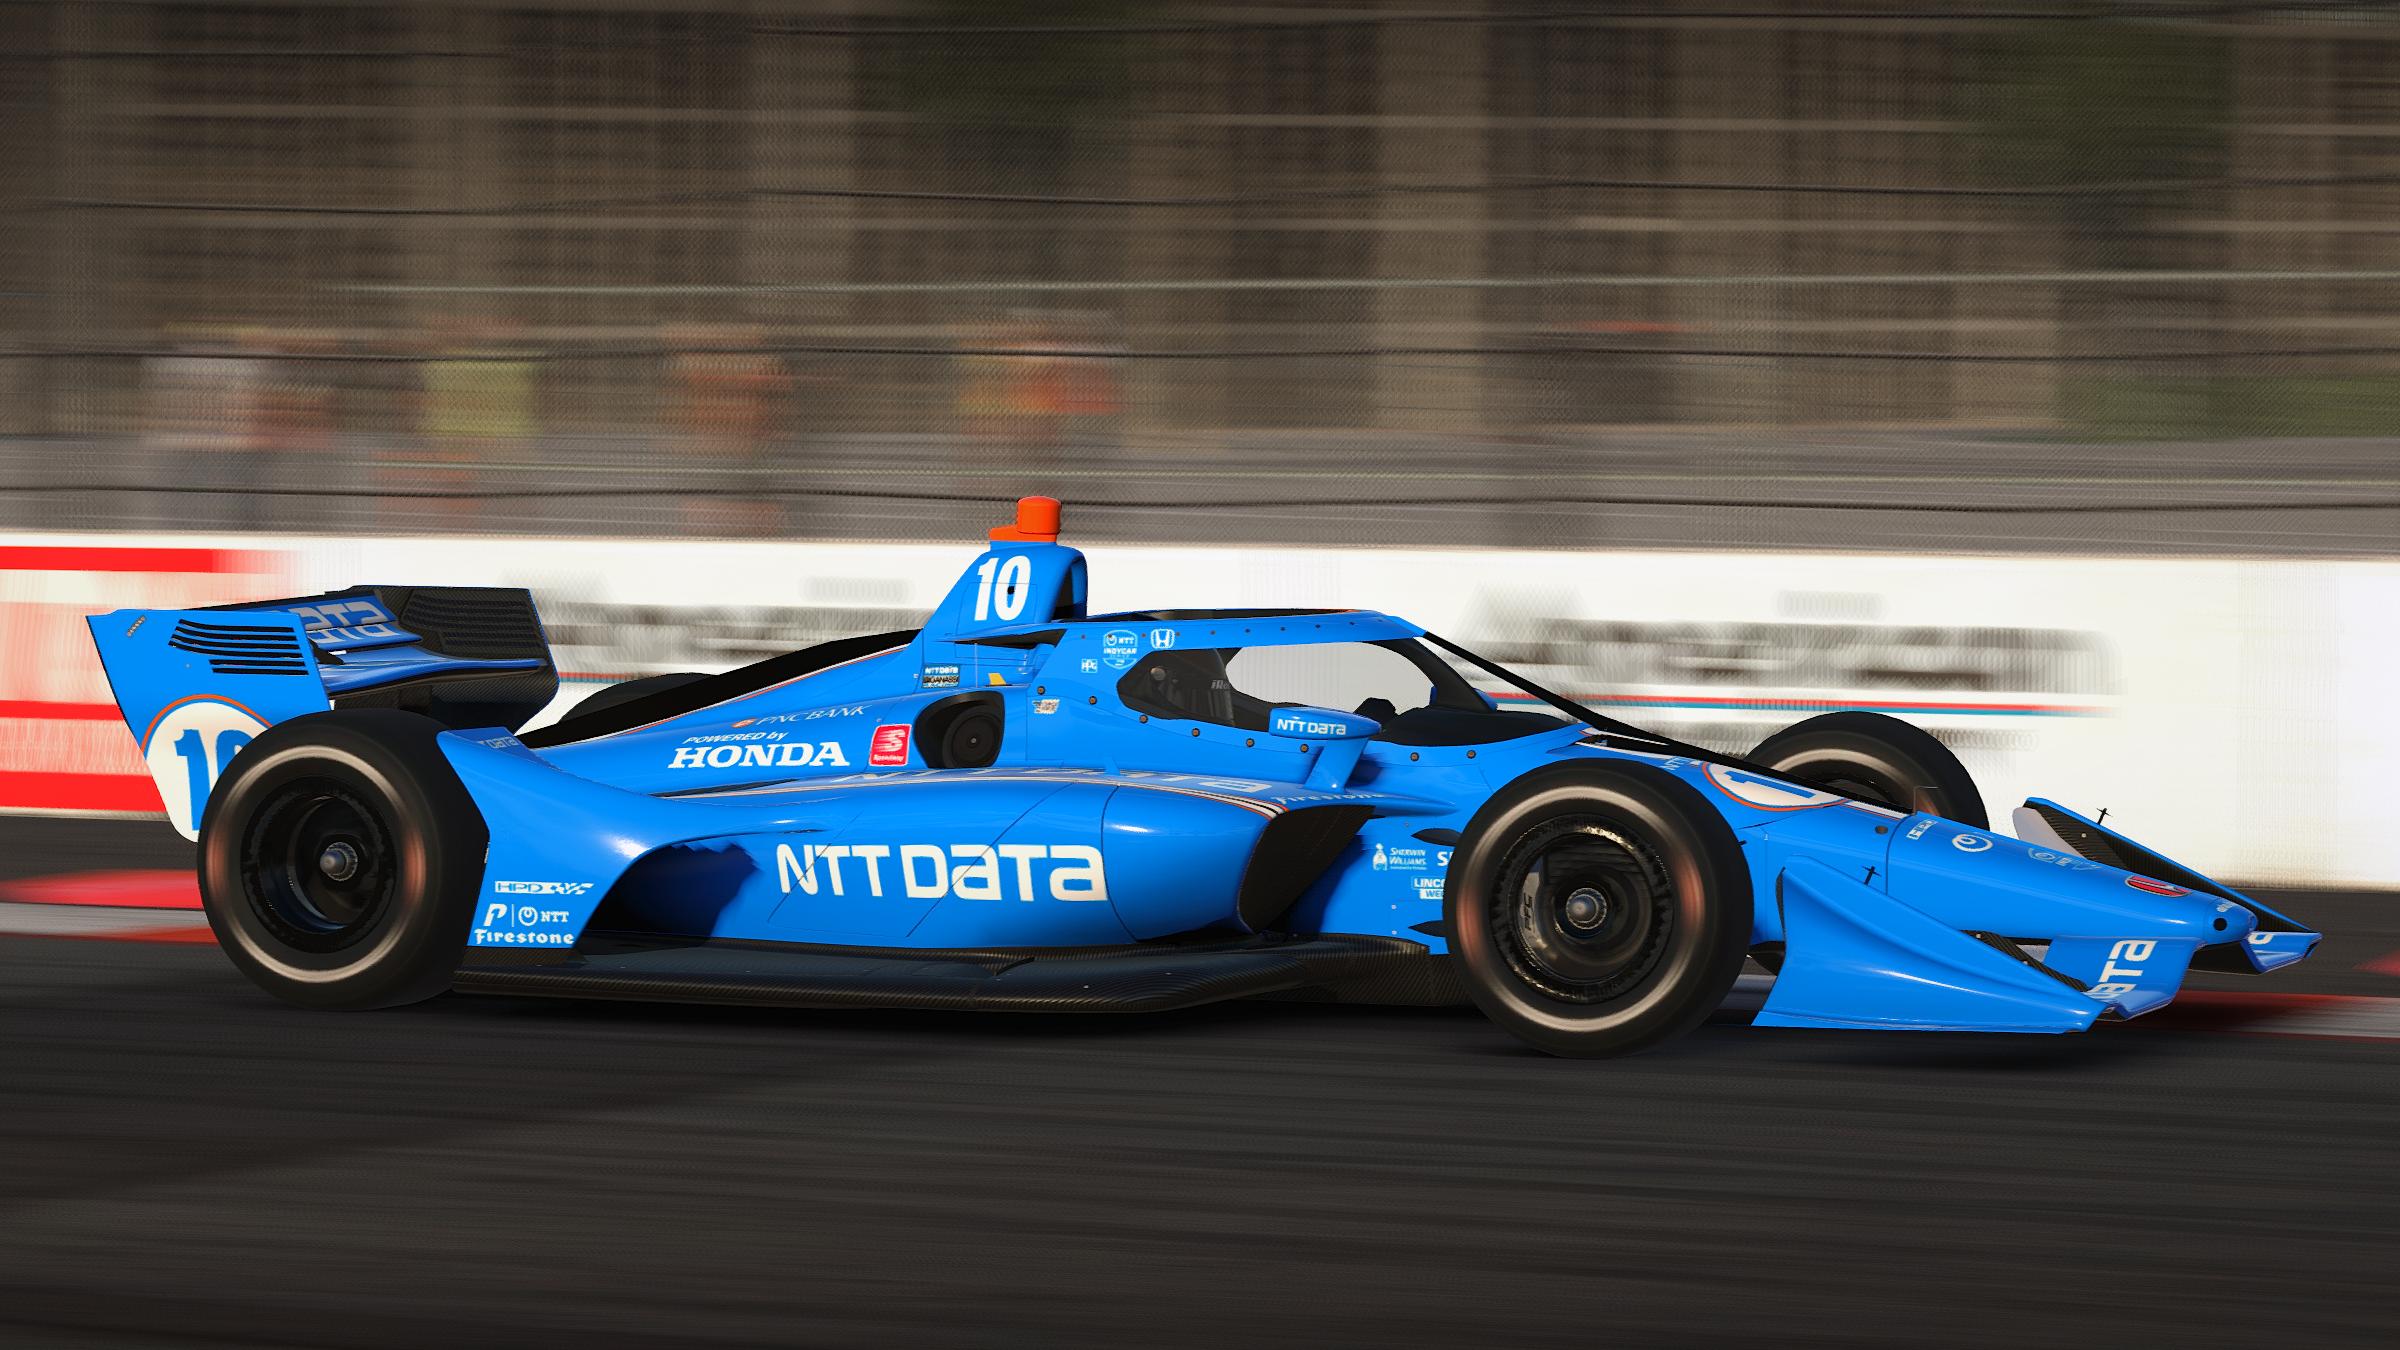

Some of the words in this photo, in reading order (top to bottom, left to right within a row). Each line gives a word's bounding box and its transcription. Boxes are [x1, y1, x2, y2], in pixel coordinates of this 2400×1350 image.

[973, 555, 1032, 622] 10
[1103, 647, 1138, 655] INDYCAR
[756, 712, 807, 726] PNC
[804, 705, 873, 721] BANK
[1276, 718, 1306, 733] NTT
[683, 732, 764, 745] POWERED
[767, 731, 790, 742] by
[667, 741, 851, 769] HONDA
[1723, 770, 1816, 799] 1
[776, 842, 891, 897] NTT
[496, 882, 546, 893] HPD
[541, 911, 570, 923] NTT
[474, 928, 575, 945] Firestone
